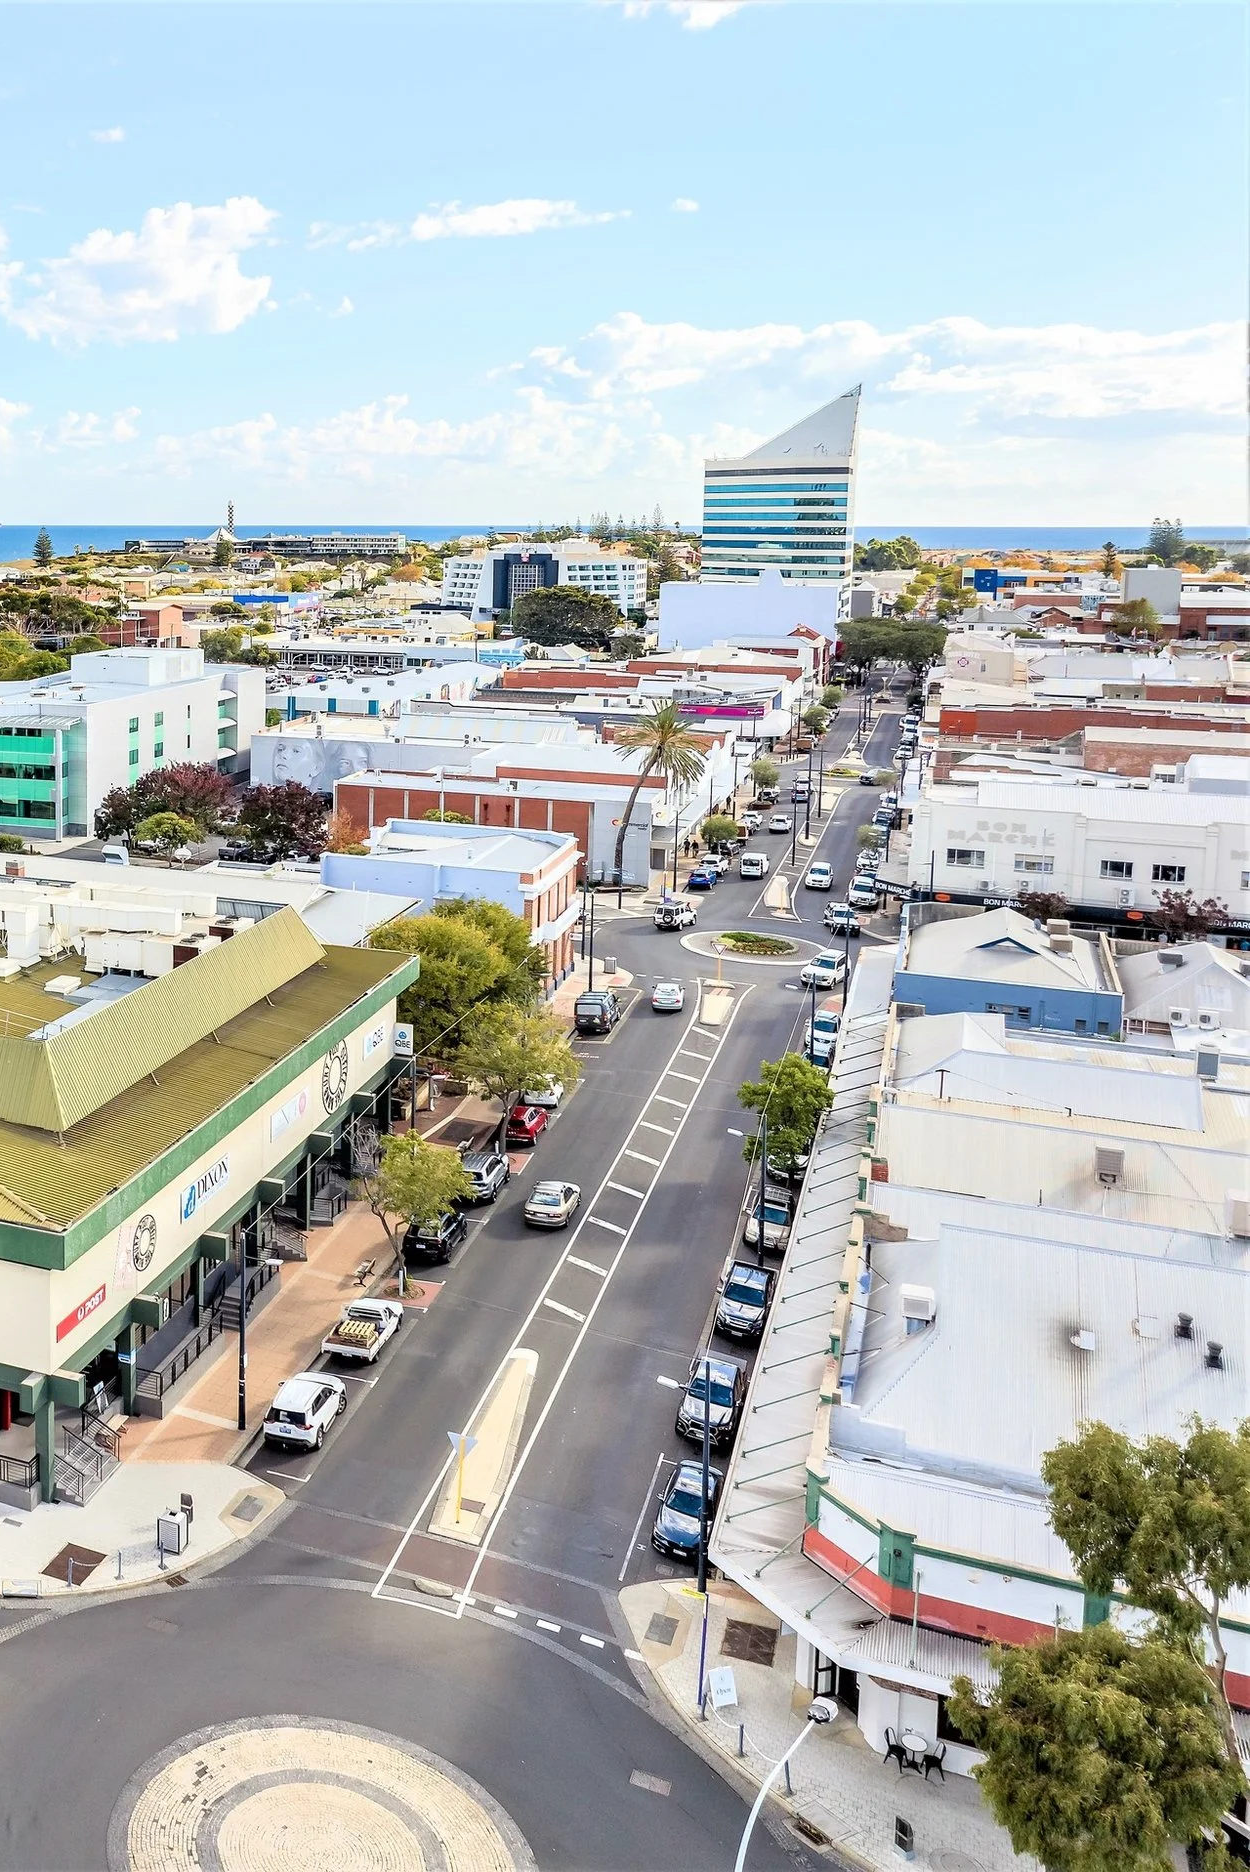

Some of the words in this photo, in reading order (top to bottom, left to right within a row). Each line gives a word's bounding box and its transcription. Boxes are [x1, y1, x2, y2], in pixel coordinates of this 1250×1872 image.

[976, 820, 1027, 833] BON
[875, 881, 888, 891] BON
[983, 898, 1001, 906] BON
[394, 1039, 411, 1049] QBE
[197, 1157, 228, 1200] DIXON
[84, 1288, 105, 1315] POST
